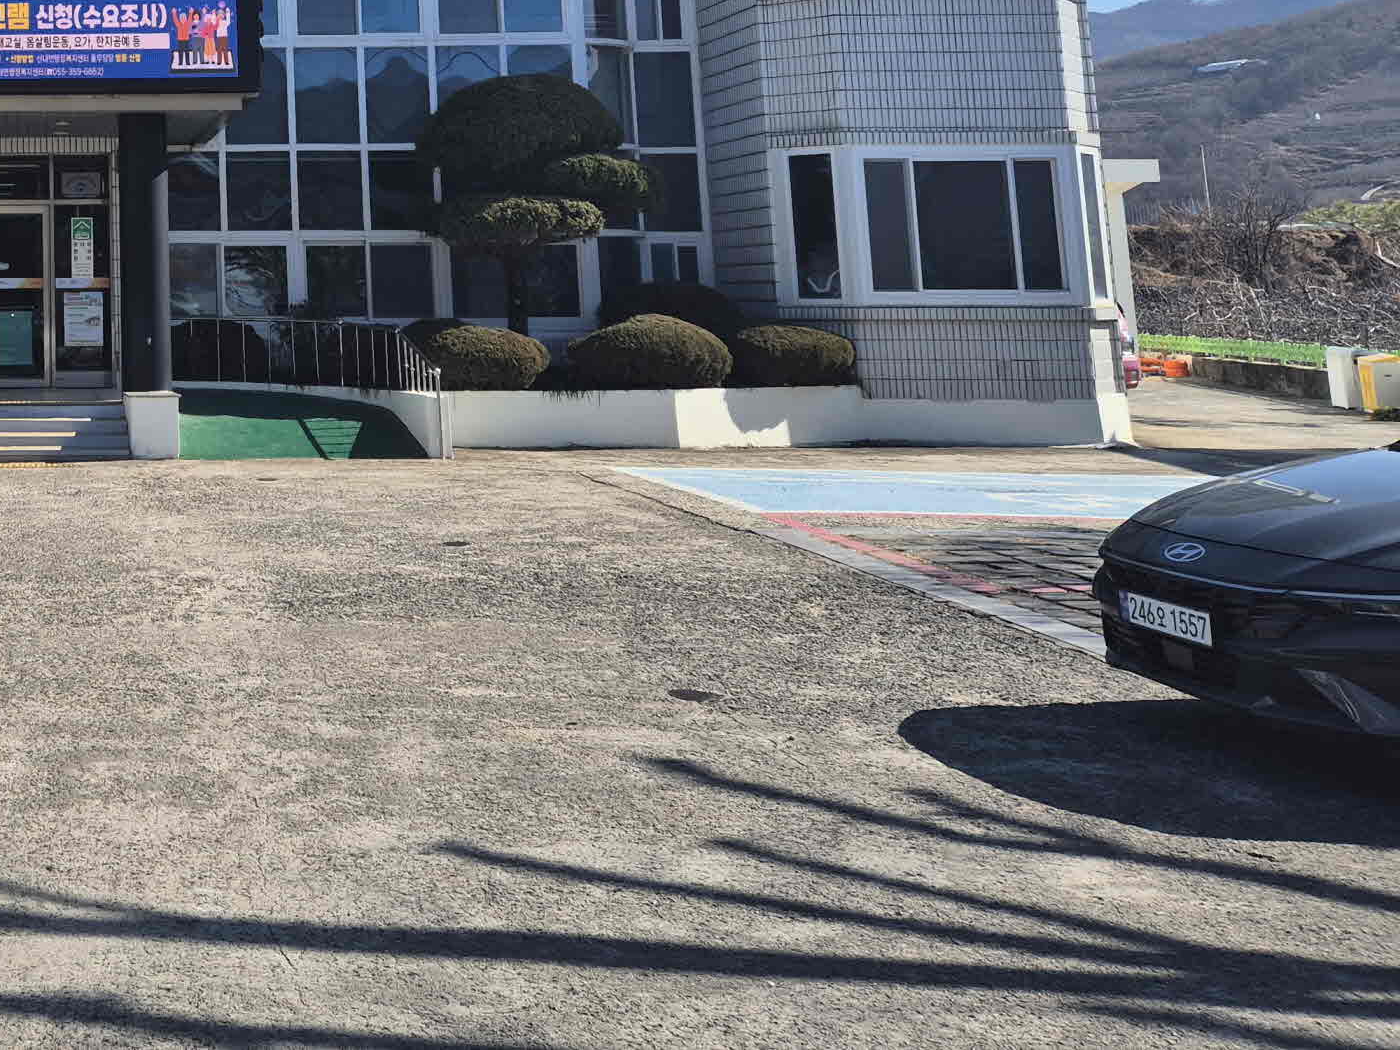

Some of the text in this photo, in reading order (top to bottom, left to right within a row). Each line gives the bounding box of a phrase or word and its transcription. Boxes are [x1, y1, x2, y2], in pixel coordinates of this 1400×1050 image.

[35, 3, 167, 30] 신청(수요조사)
[74, 36, 94, 50] 요가,
[96, 35, 130, 48] 한지공예
[132, 35, 141, 48] 등
[1129, 596, 1207, 640] 246오 1557
